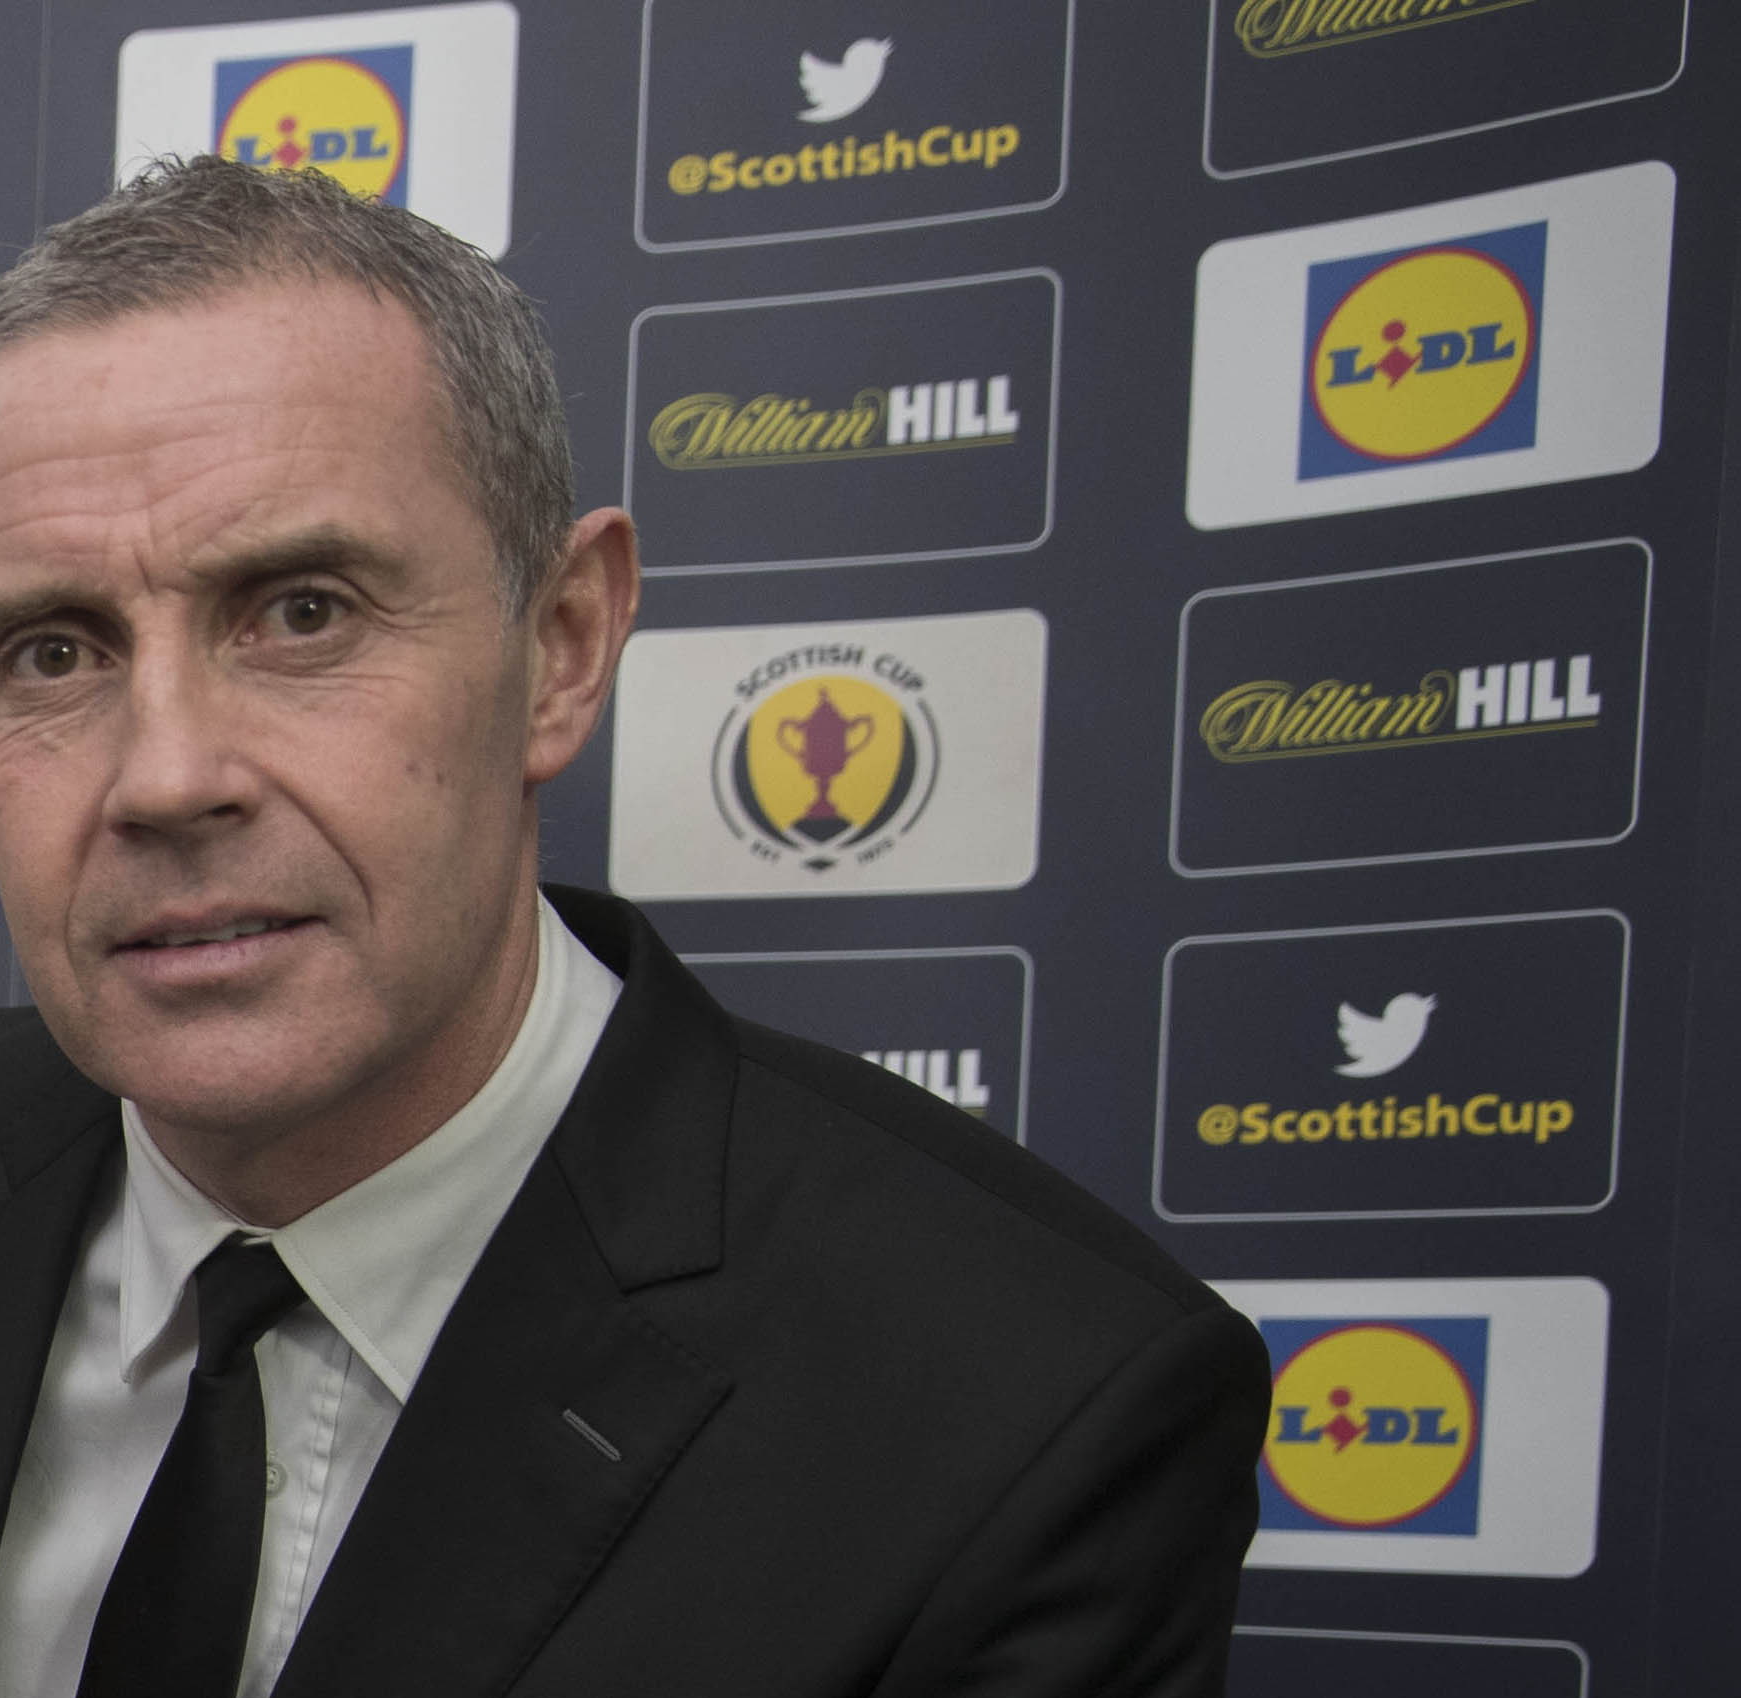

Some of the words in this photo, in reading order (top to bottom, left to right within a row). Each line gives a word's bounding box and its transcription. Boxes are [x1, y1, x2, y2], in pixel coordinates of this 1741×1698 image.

[668, 122, 1020, 195] @ScottishCup
[649, 388, 888, 471] William
[886, 374, 1020, 446] HILL
[735, 643, 865, 703] SCOTTISH
[872, 653, 925, 698] CUP
[1200, 670, 1458, 764] William
[1456, 655, 1601, 730] HILL
[1197, 1093, 1575, 1147] @ScottishCup
